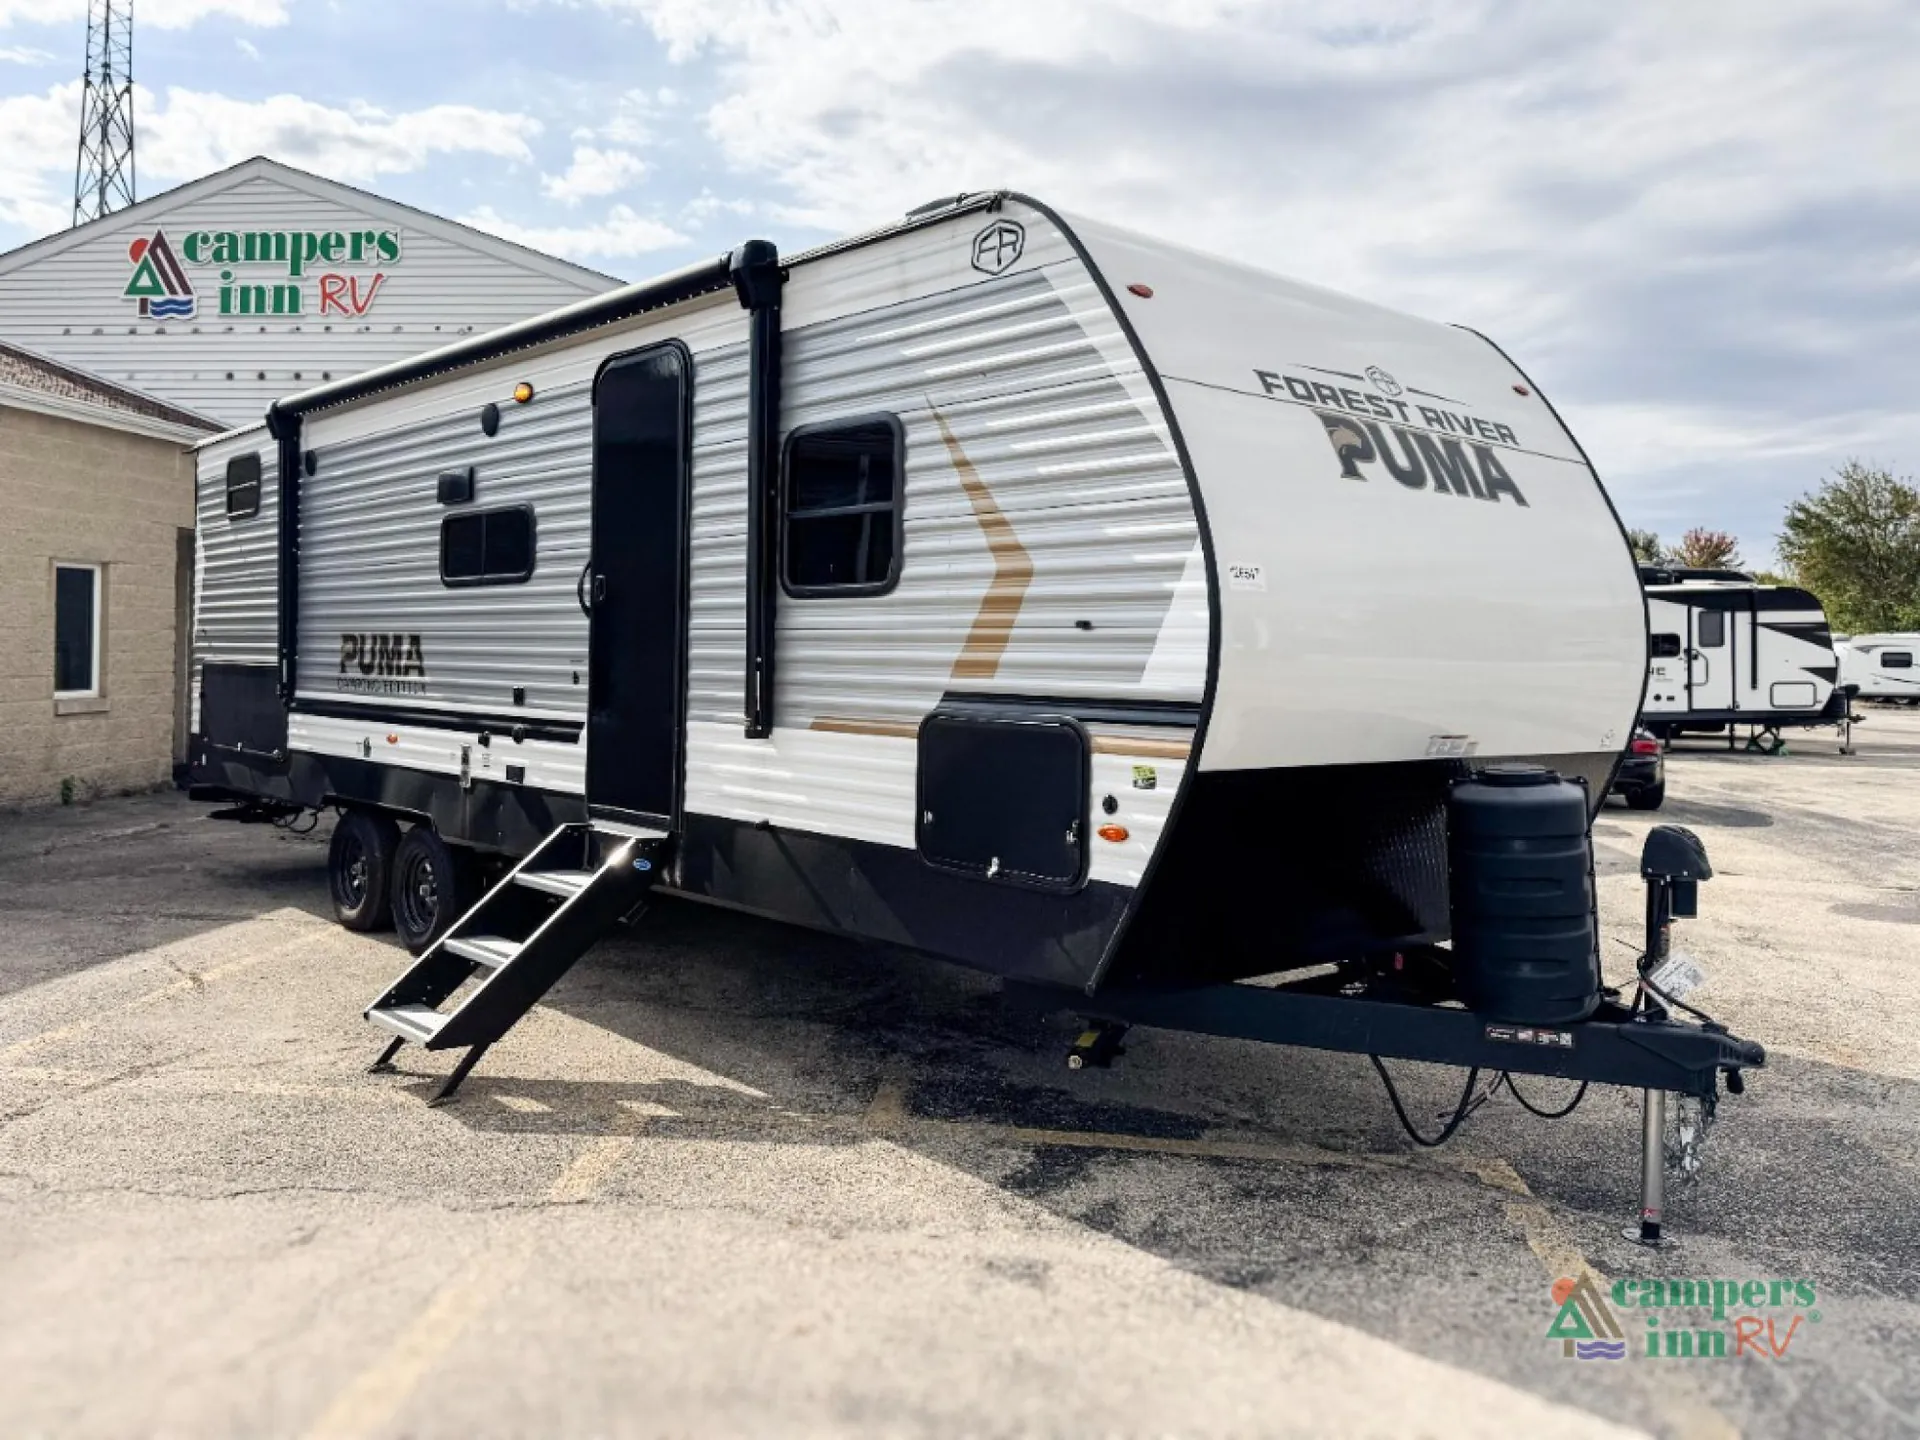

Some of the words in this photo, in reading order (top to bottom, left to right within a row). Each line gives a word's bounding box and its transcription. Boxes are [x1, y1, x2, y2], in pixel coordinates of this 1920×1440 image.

[183, 231, 399, 276] campers
[219, 270, 301, 314] inn
[319, 273, 384, 314] RV
[1252, 369, 1410, 422] FOREST
[1416, 404, 1520, 447] RIVER
[1311, 407, 1531, 508] PUMA
[340, 634, 425, 677] PUMA
